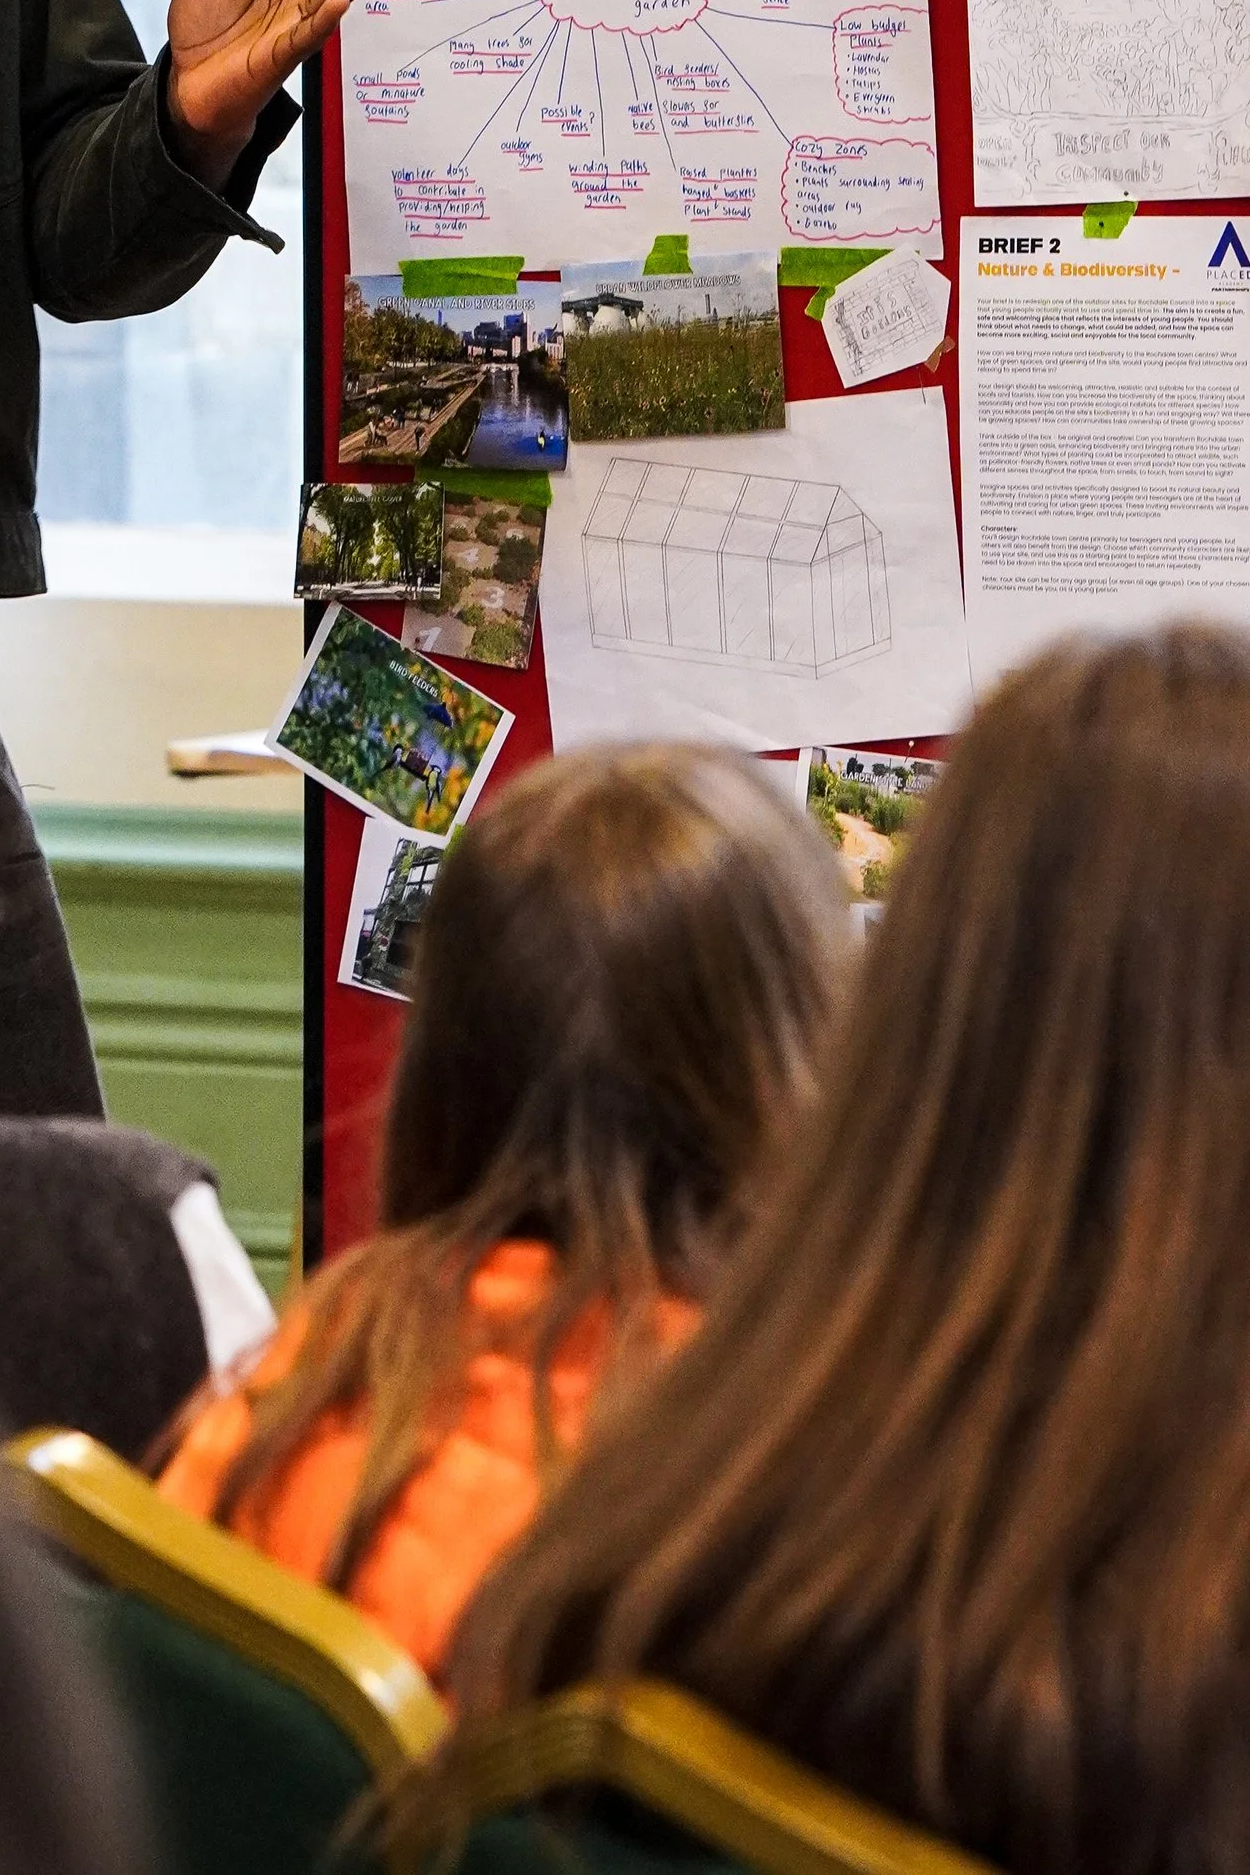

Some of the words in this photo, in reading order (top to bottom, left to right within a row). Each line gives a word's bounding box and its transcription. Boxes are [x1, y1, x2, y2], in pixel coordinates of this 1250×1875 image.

[840, 20, 862, 31] Low
[871, 18, 906, 37] budget
[450, 61, 484, 74] cooling
[655, 65, 674, 76] Bird
[705, 77, 730, 88] boxes
[801, 161, 837, 175] Benches
[978, 238, 1043, 254] BRIEF
[1049, 239, 1061, 253] 2
[978, 263, 1038, 277] Nature
[1042, 263, 1055, 277] &
[1060, 263, 1167, 281] Biodiversity
[628, 279, 692, 292] WILDFLOWER
[693, 275, 741, 288] MEADOWS
[378, 296, 410, 308] GREEN
[413, 298, 446, 309] CANAL
[450, 299, 472, 309] AND
[474, 299, 503, 309] RIVER
[504, 299, 535, 310] SIDES
[389, 660, 408, 676] BIRD
[407, 670, 439, 697] FEEDERS
